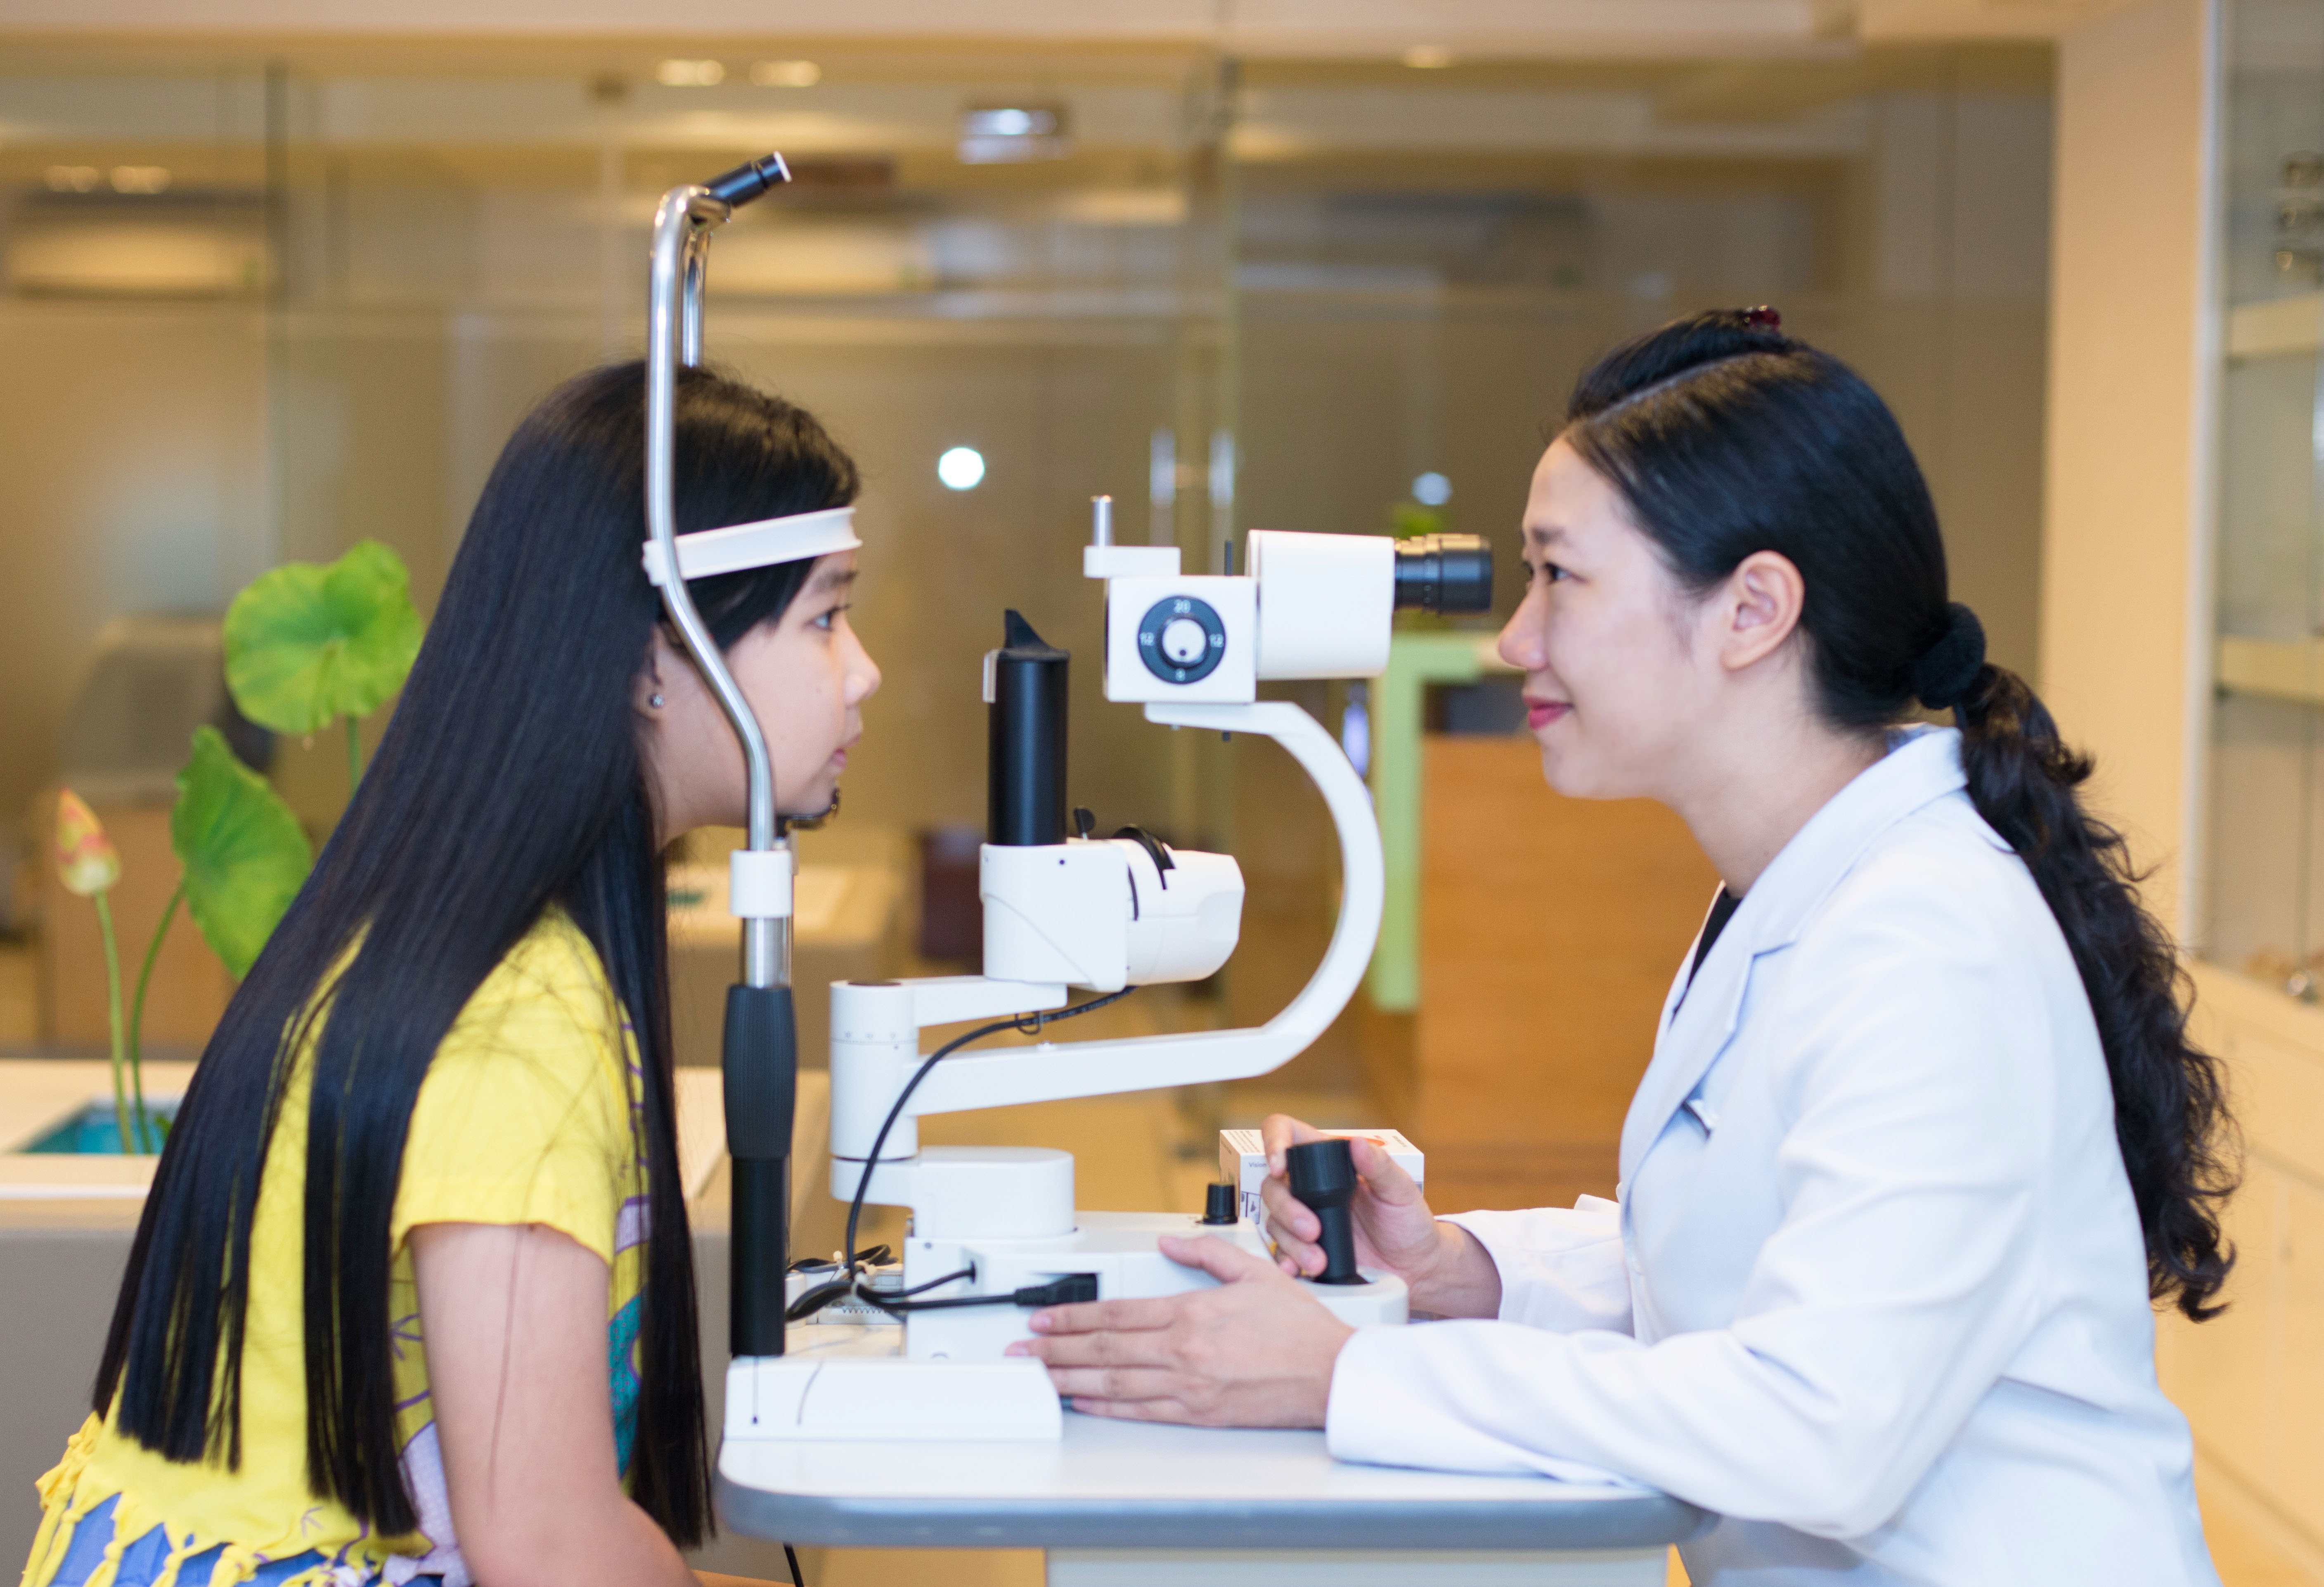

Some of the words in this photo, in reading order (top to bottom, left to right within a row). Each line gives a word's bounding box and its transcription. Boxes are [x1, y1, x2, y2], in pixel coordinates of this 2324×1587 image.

[1174, 599, 1191, 613] 20
[1139, 632, 1155, 646] 12
[1208, 634, 1224, 648] 12
